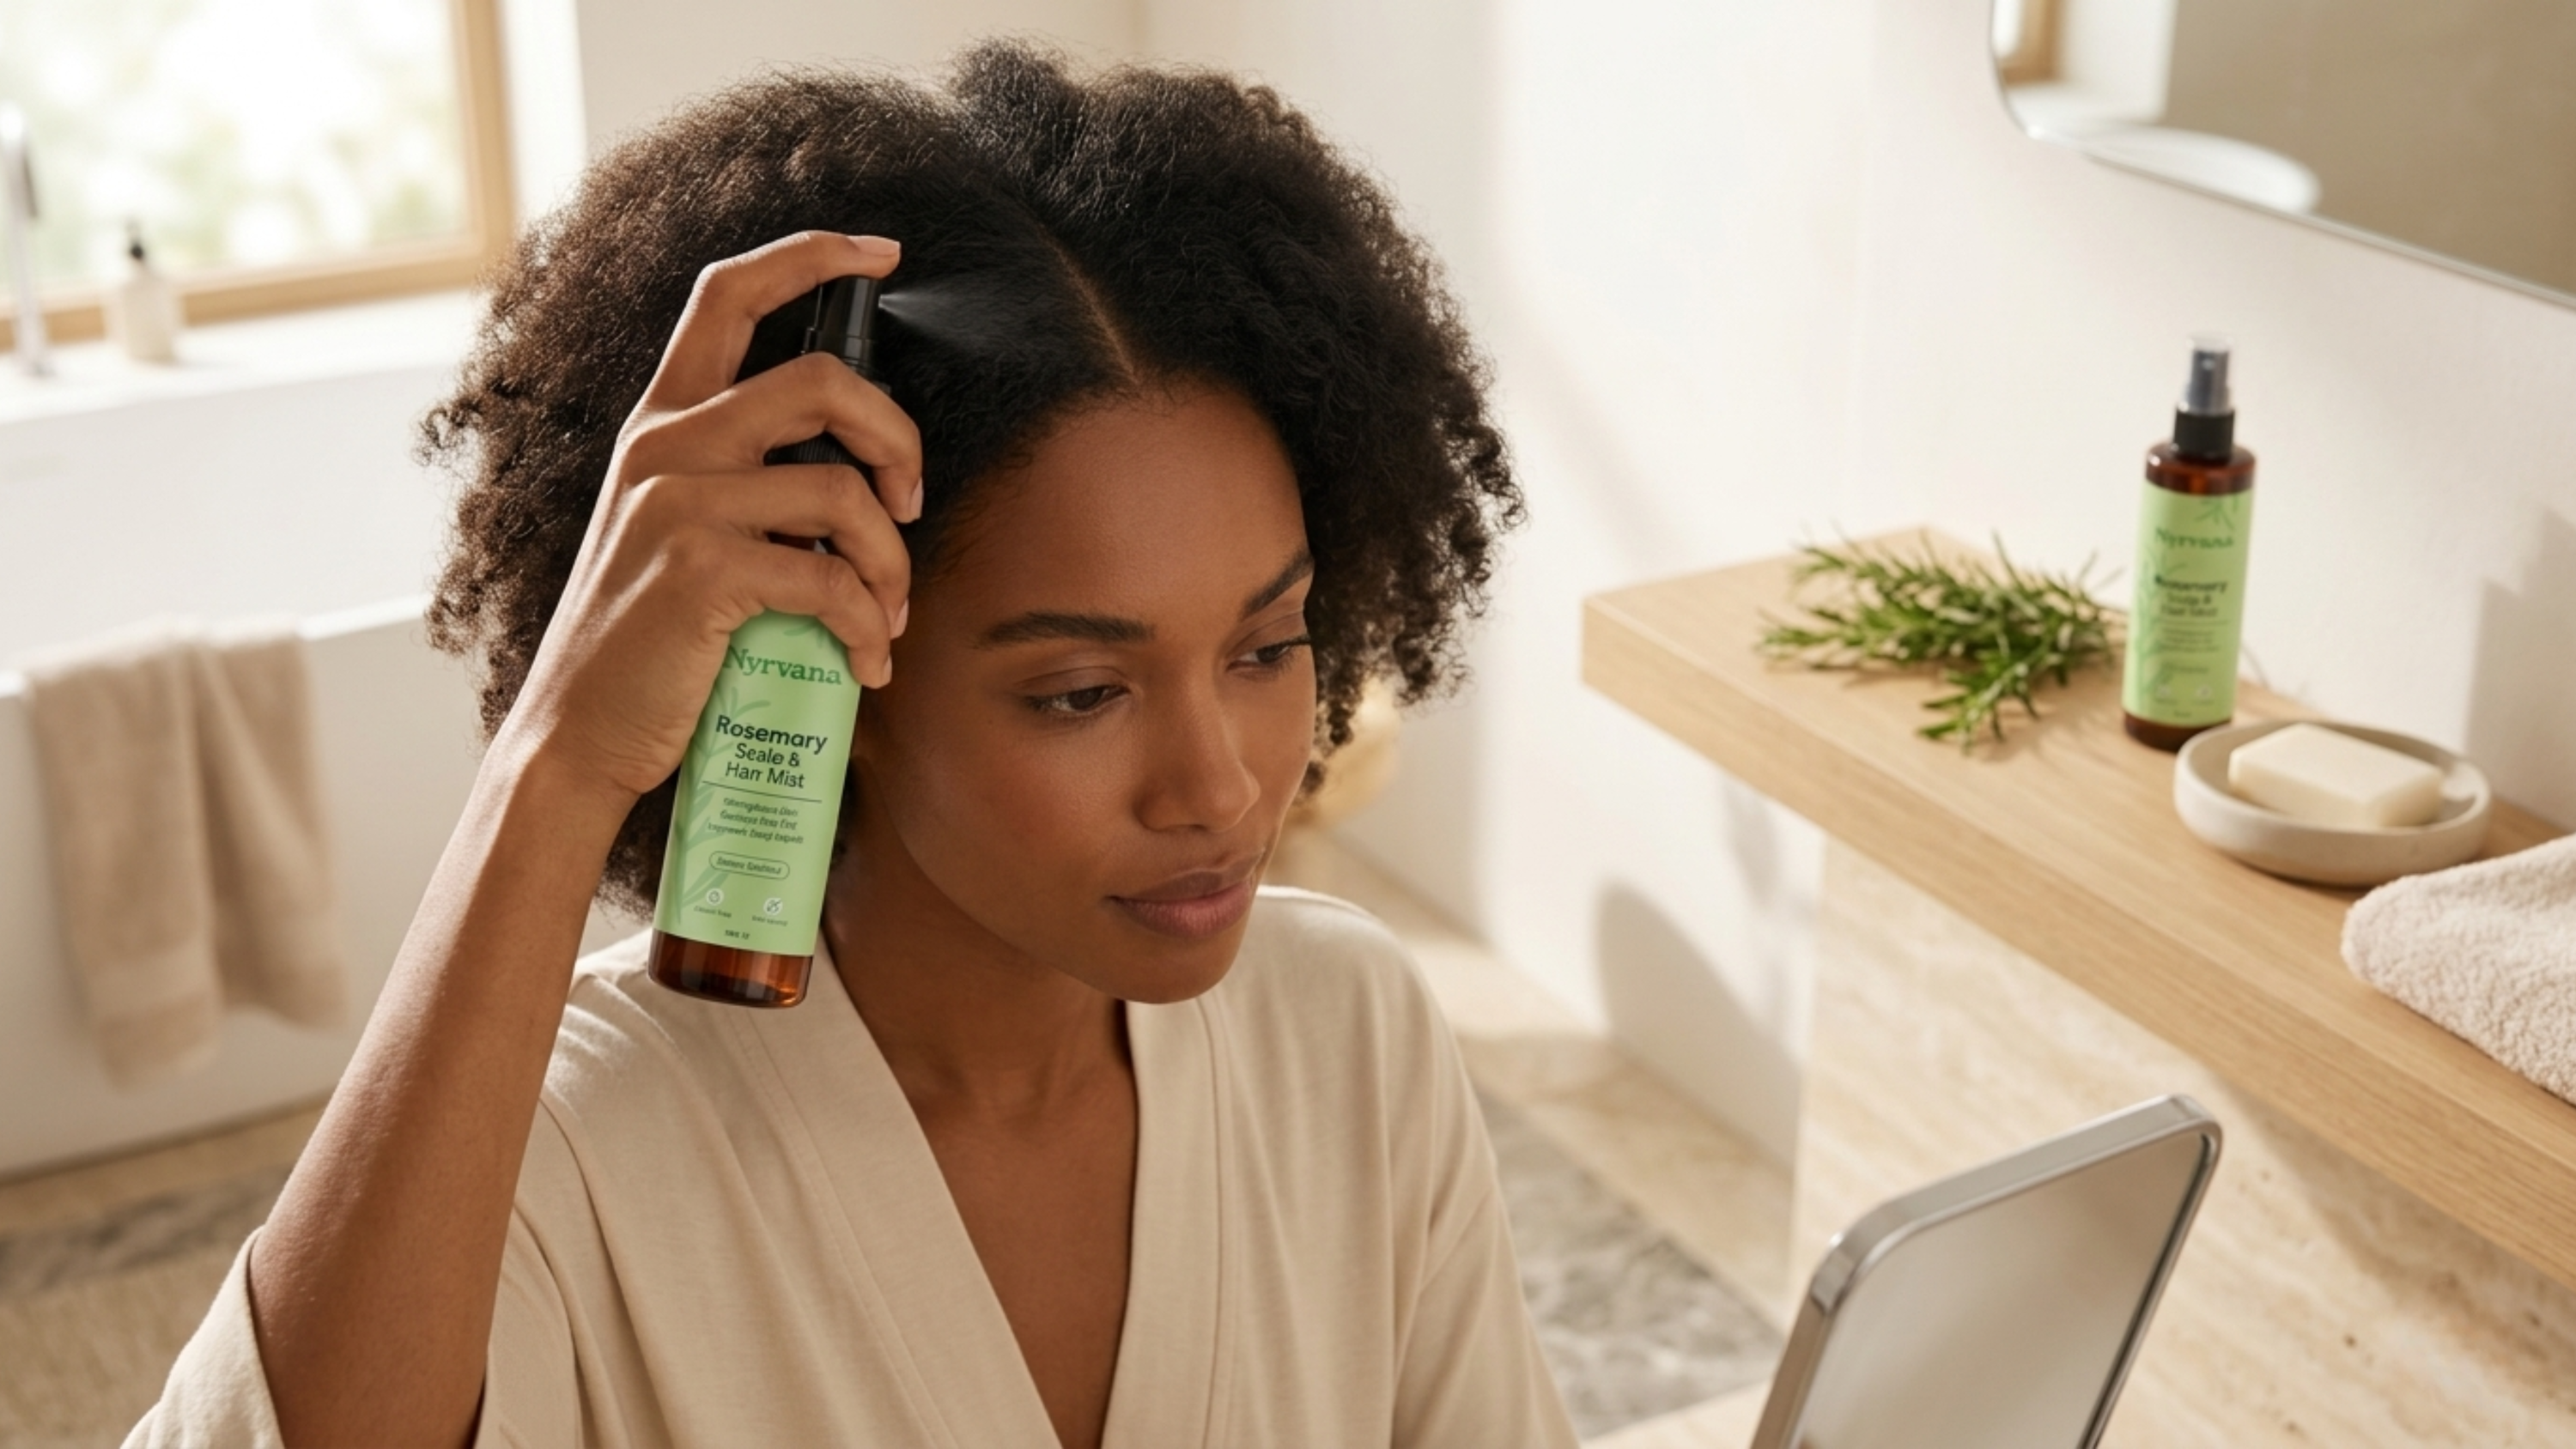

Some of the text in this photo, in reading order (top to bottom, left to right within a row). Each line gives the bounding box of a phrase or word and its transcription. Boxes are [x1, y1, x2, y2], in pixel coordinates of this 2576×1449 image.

[724, 646, 841, 685] Nyrvana
[716, 714, 828, 755] Rosemary
[788, 752, 800, 767] &
[767, 767, 805, 788] Mist
